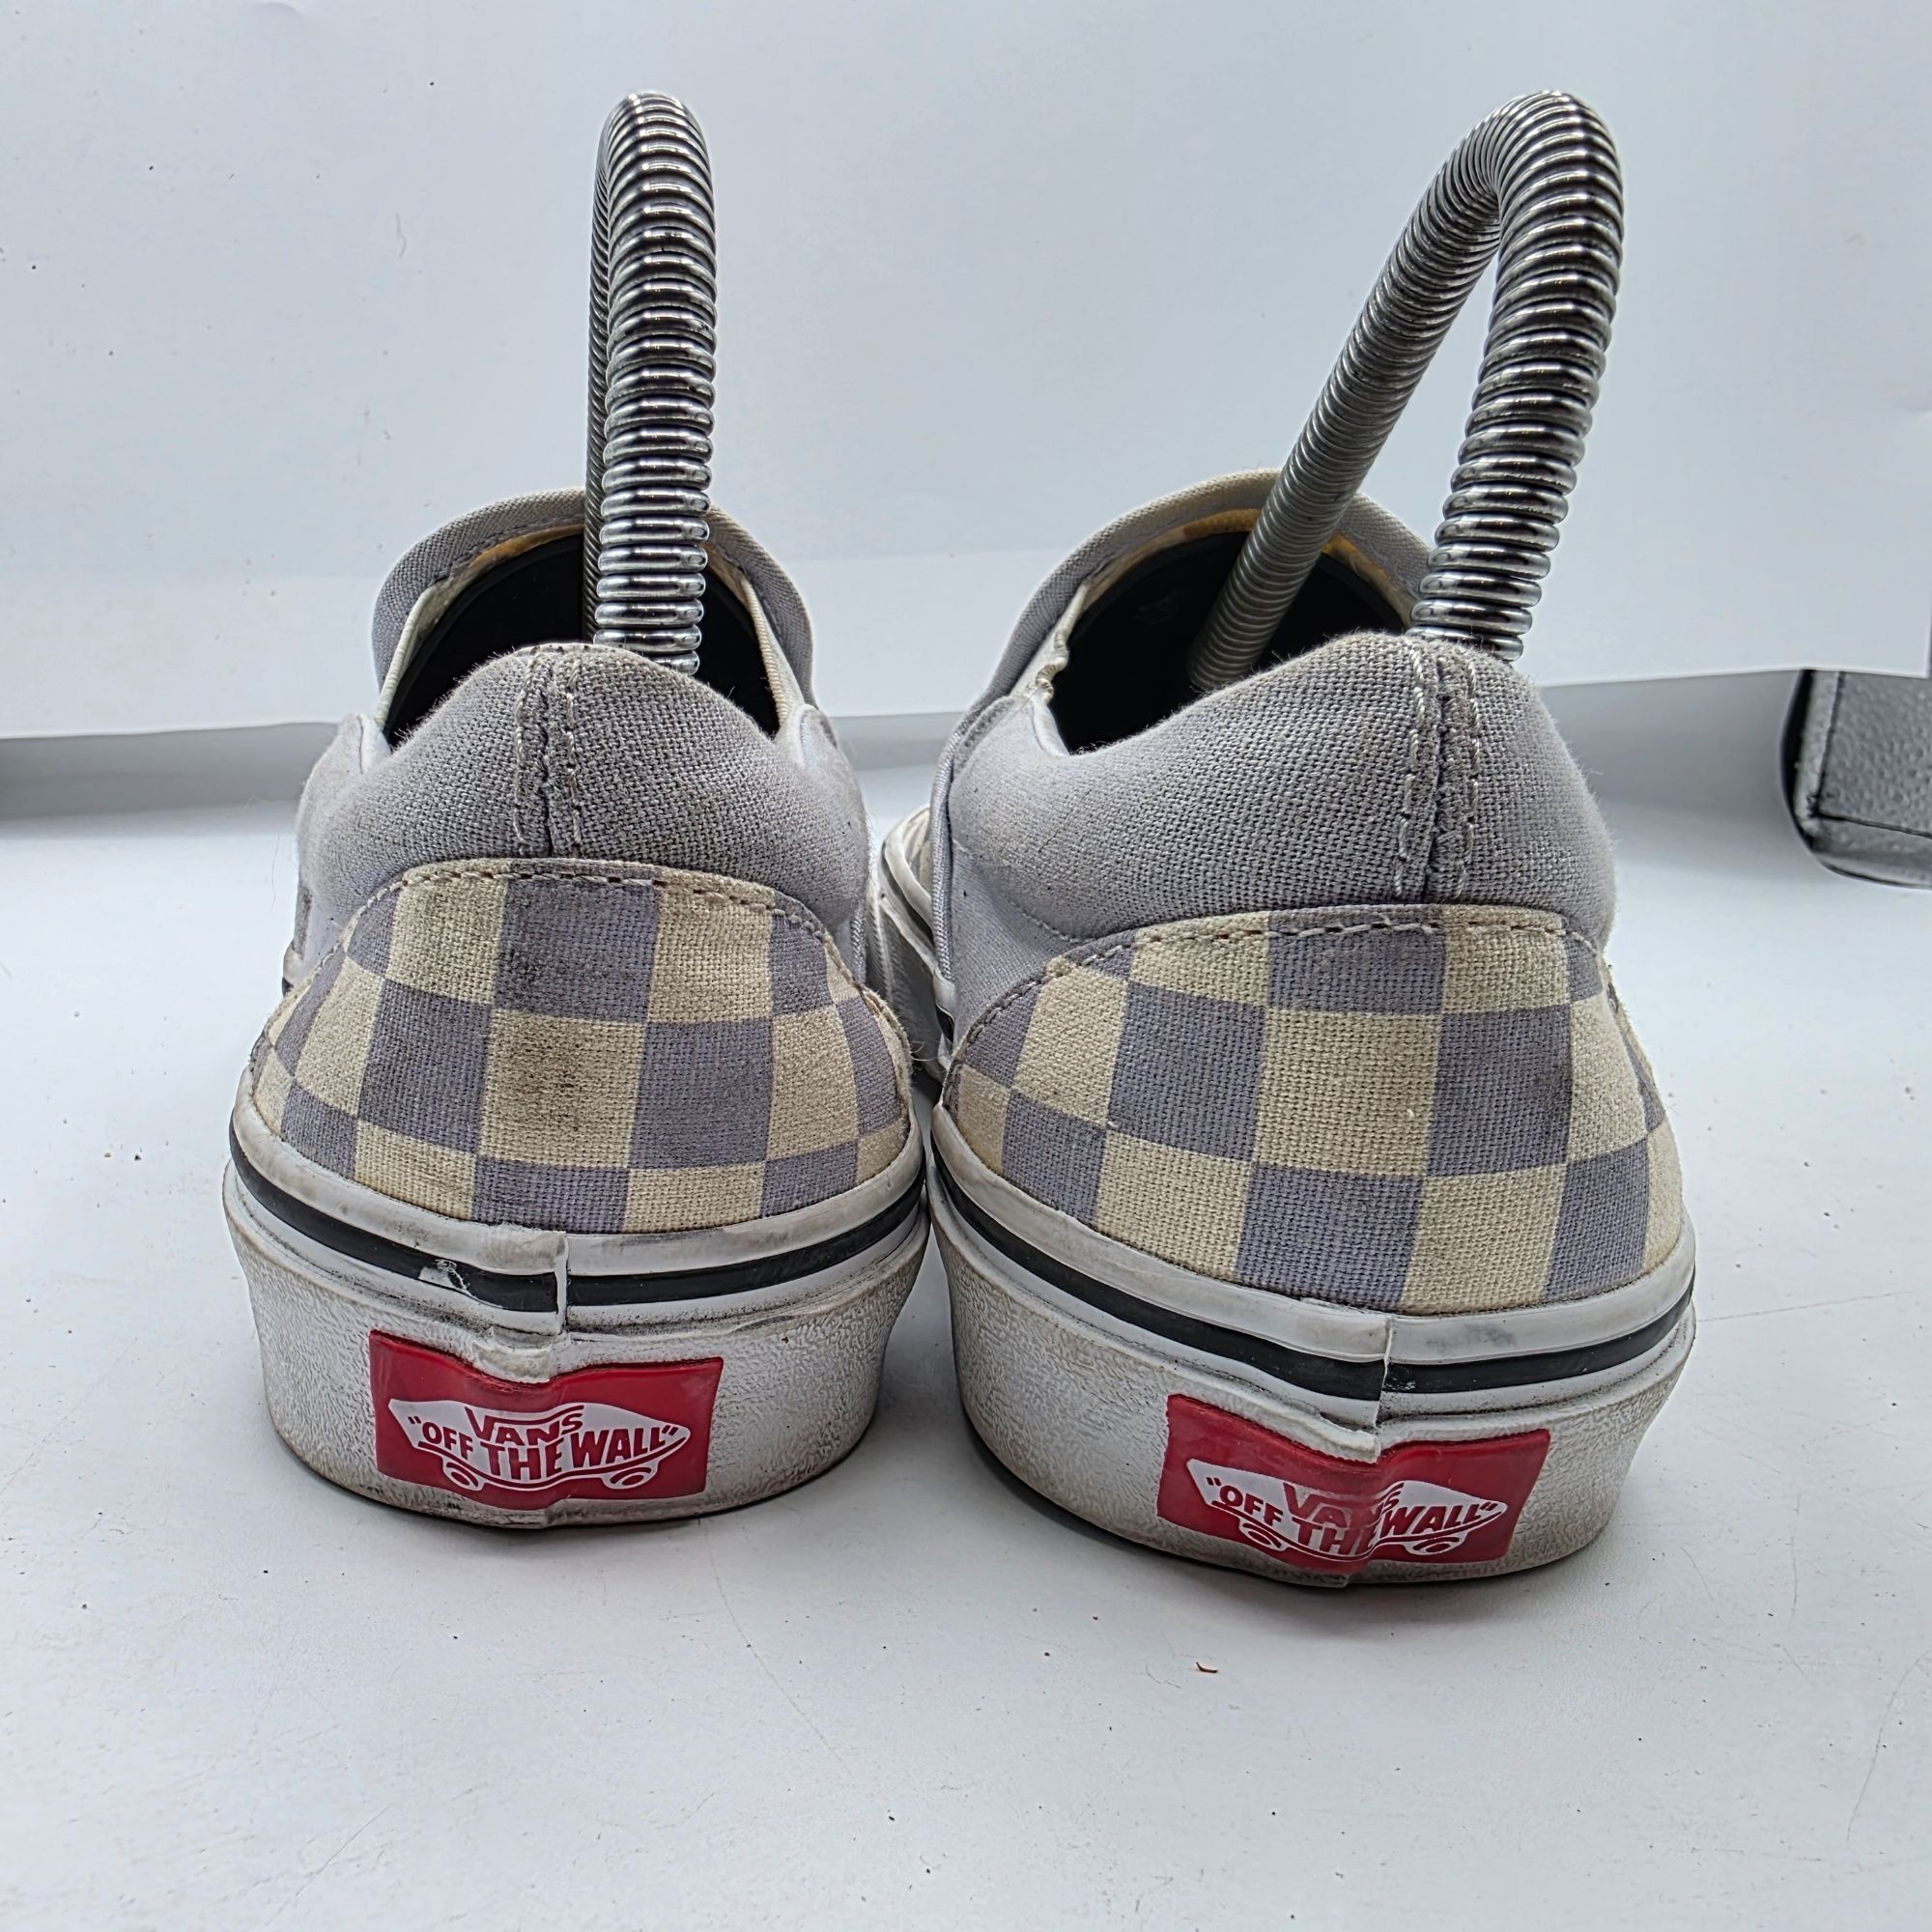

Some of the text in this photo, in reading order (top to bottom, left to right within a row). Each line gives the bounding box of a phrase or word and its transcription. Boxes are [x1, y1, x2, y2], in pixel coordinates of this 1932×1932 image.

[407, 1415, 679, 1480] "OFF THE WALL"
[464, 1405, 584, 1446] VANS
[1206, 1476, 1284, 1524] "OFF
[1379, 1500, 1499, 1539] WALL"
